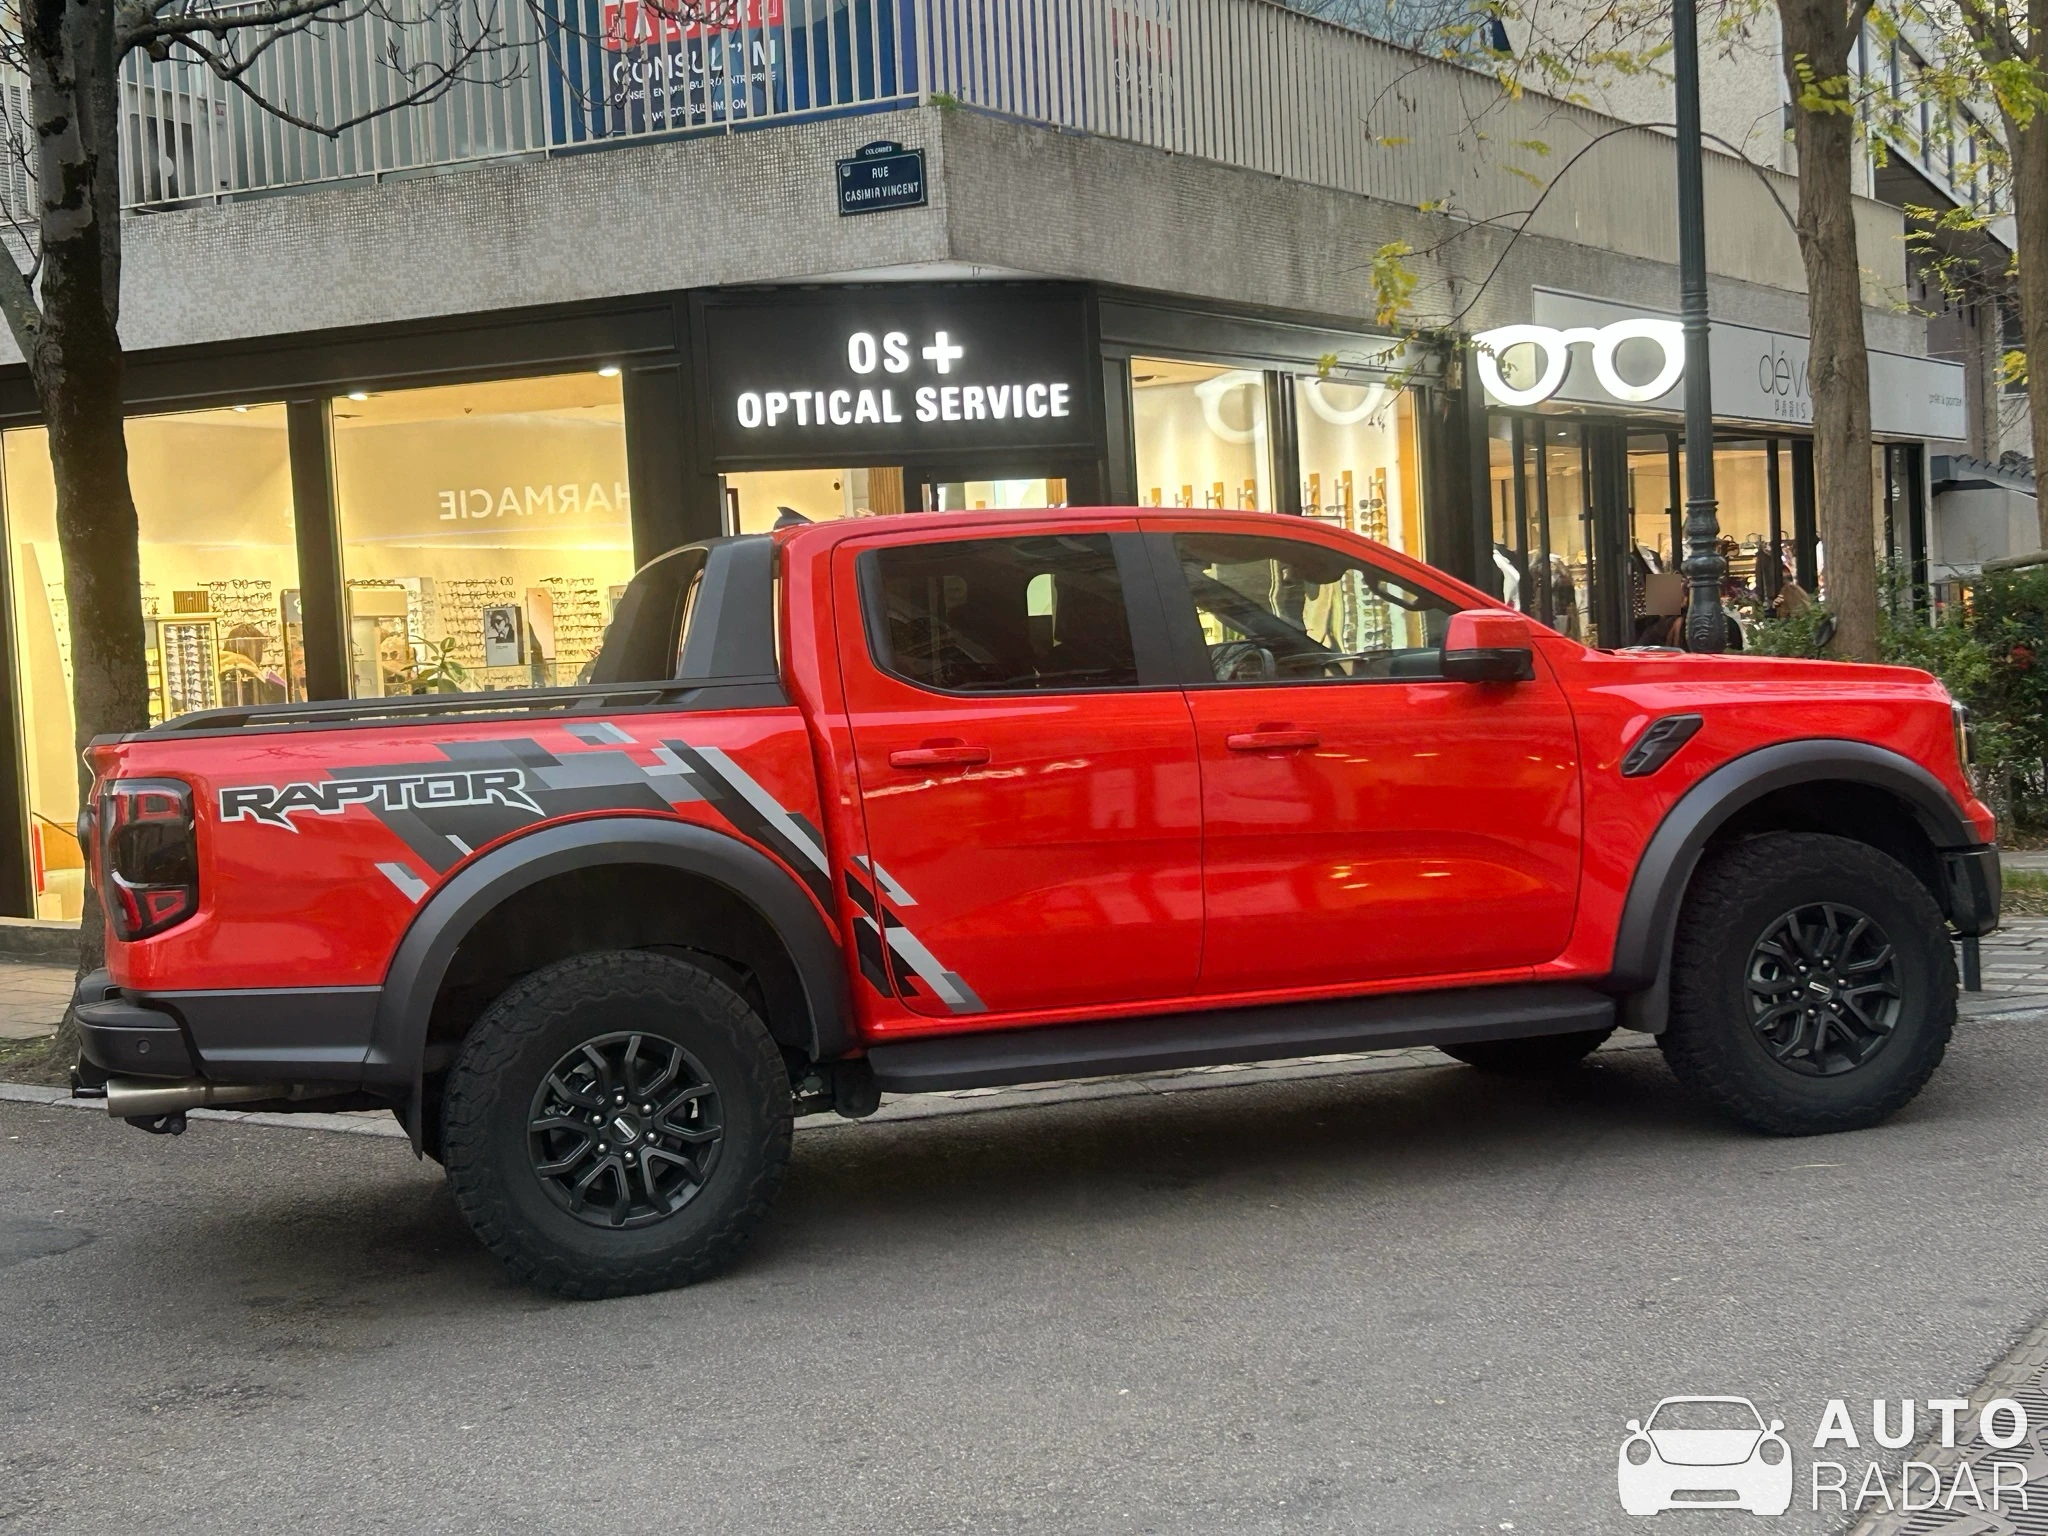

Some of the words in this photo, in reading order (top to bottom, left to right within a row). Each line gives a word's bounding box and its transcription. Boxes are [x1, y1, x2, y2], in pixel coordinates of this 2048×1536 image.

[872, 166, 888, 179] RUE
[845, 187, 881, 203] CASIMIR
[882, 181, 919, 198] VINCENT
[736, 388, 902, 429] OPTICAL
[915, 382, 1071, 422] SERVICE
[218, 769, 547, 833] RAPTOR
